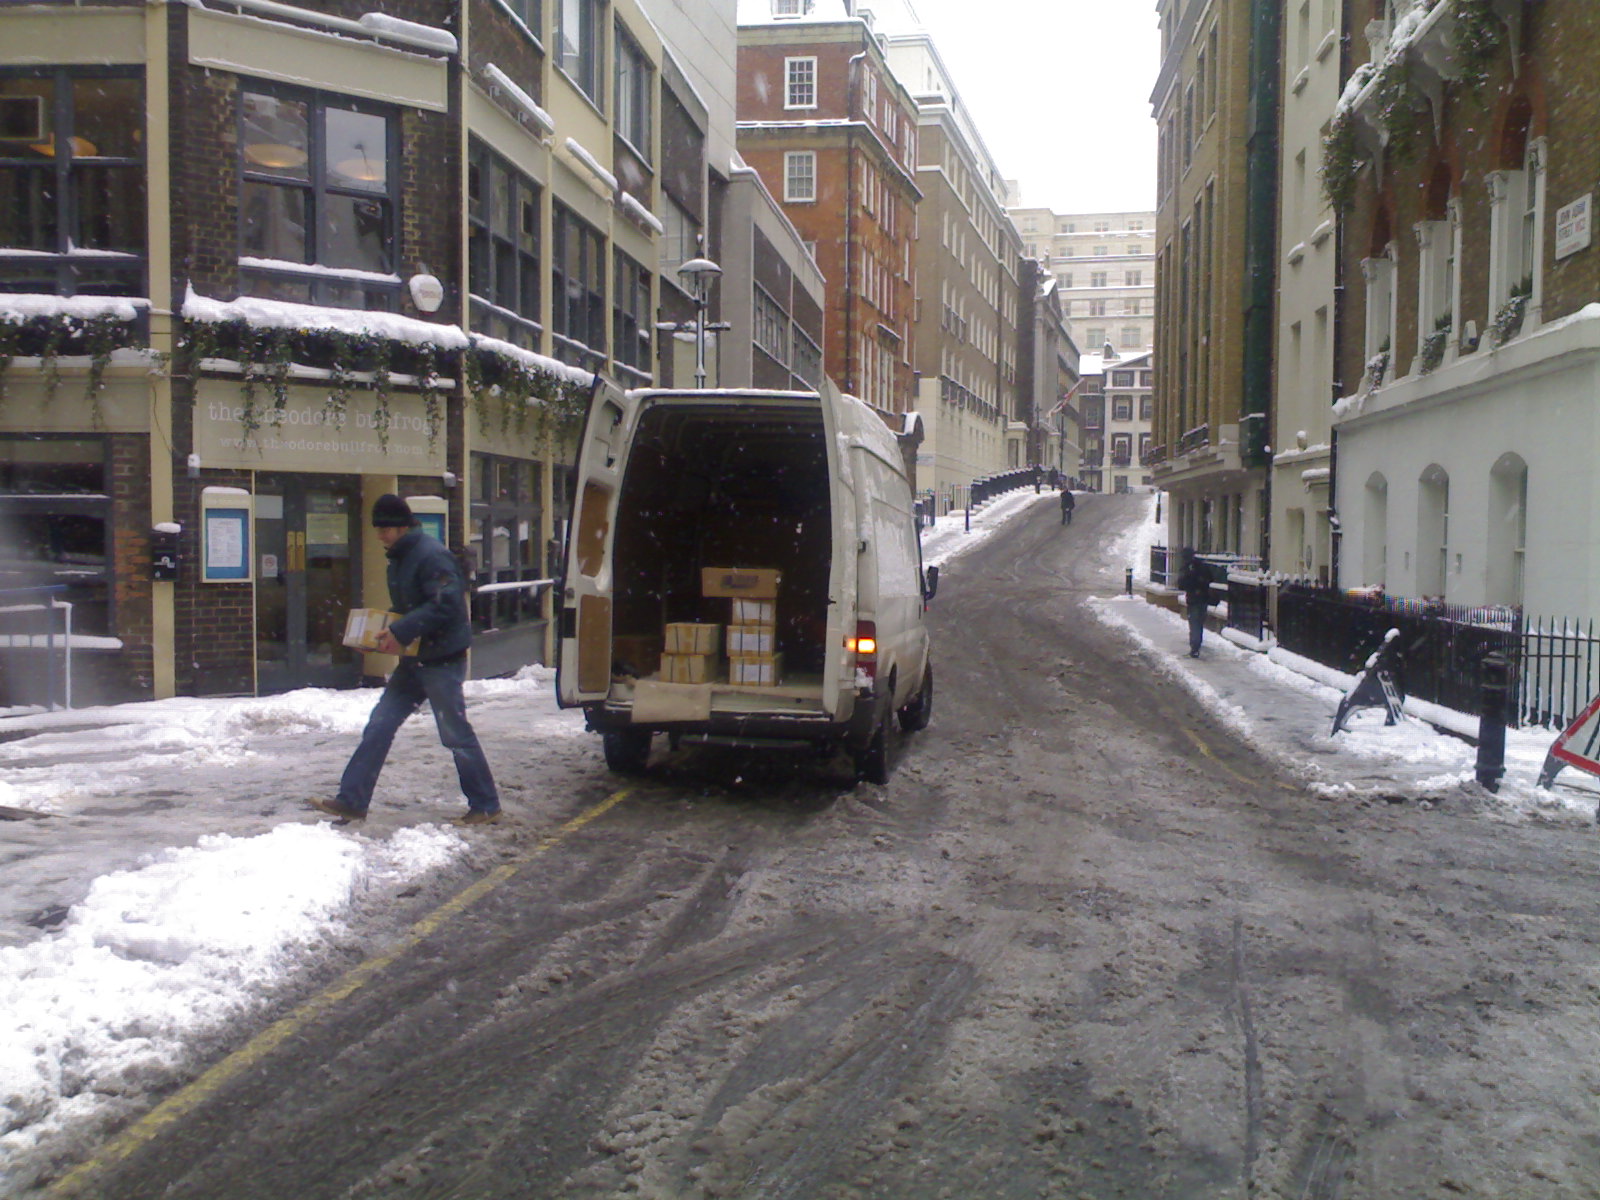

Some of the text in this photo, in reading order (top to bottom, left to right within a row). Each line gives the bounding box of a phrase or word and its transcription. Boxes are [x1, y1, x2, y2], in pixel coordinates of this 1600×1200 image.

[208, 401, 434, 436] the heodore bufrog
